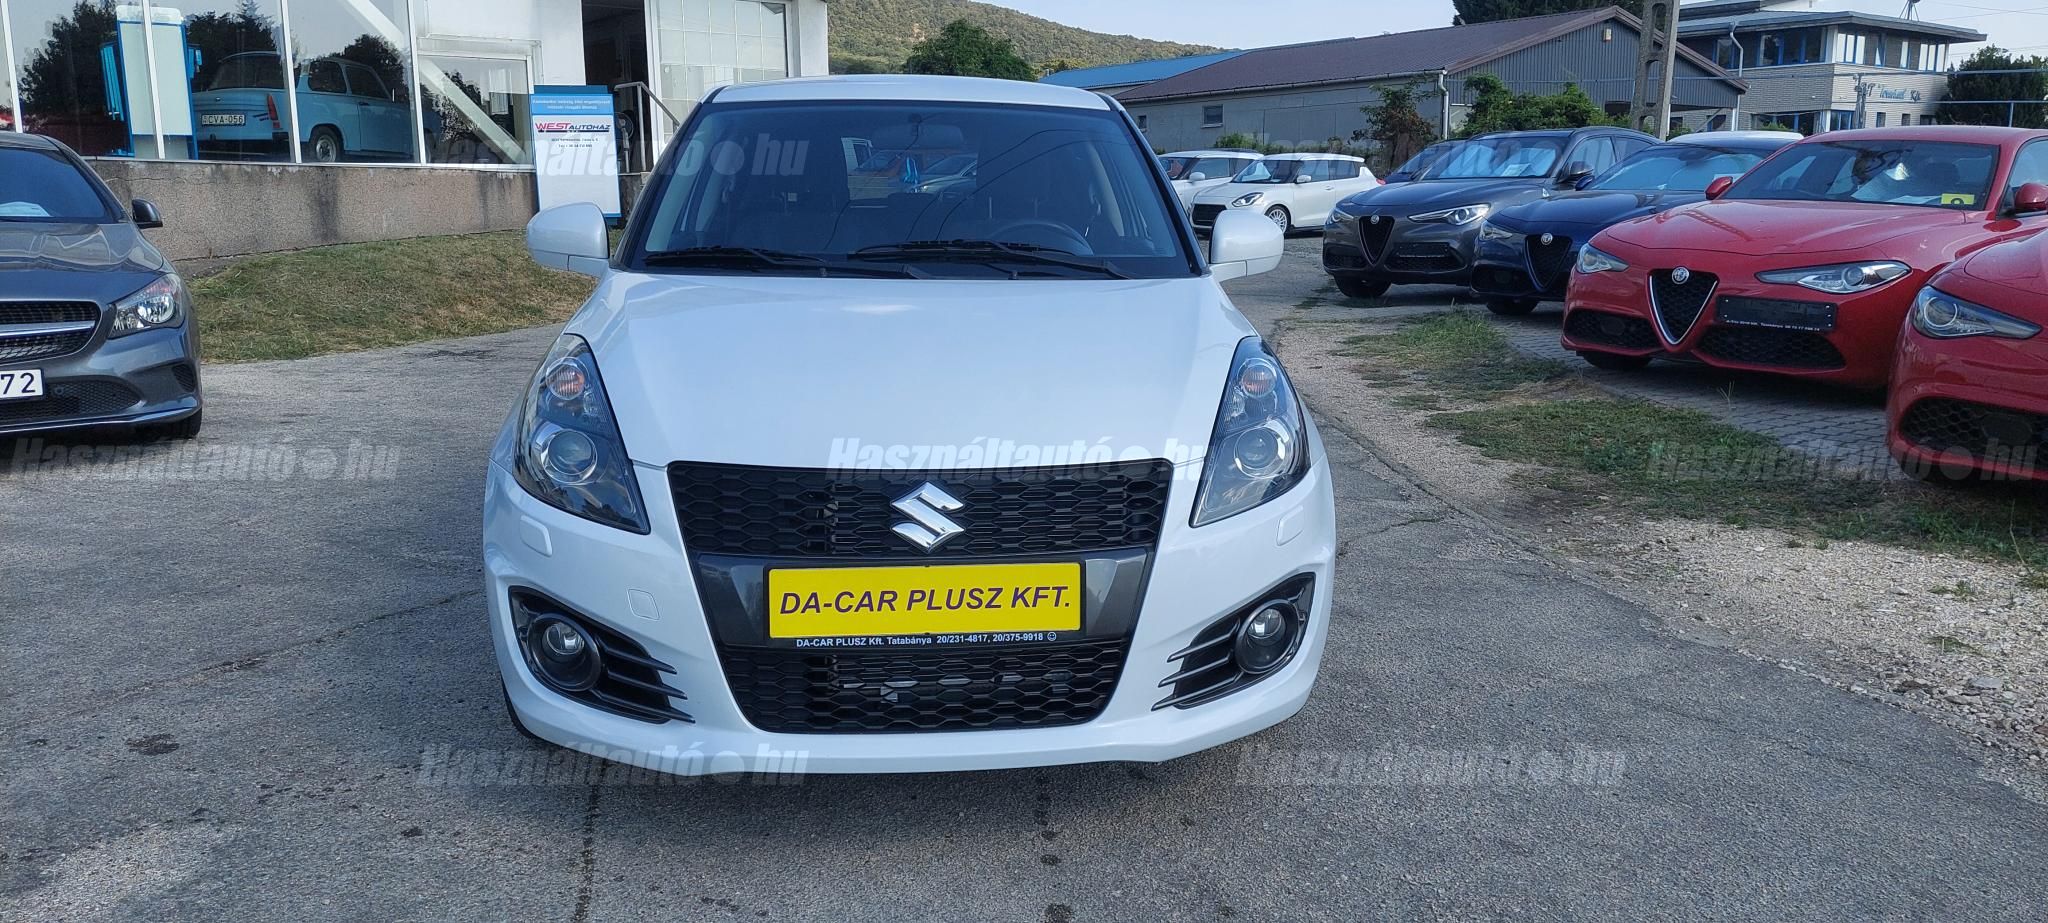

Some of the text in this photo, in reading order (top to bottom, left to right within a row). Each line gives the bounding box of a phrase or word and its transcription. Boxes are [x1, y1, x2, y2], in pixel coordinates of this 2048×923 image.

[208, 115, 244, 124] CVA-056
[780, 585, 1070, 614] DA-CAR PLUSZ KFT.
[796, 632, 1043, 647] DA-CAR PLUSZ Kft. Tatabánya 20/231-4817, 20/375-9918
